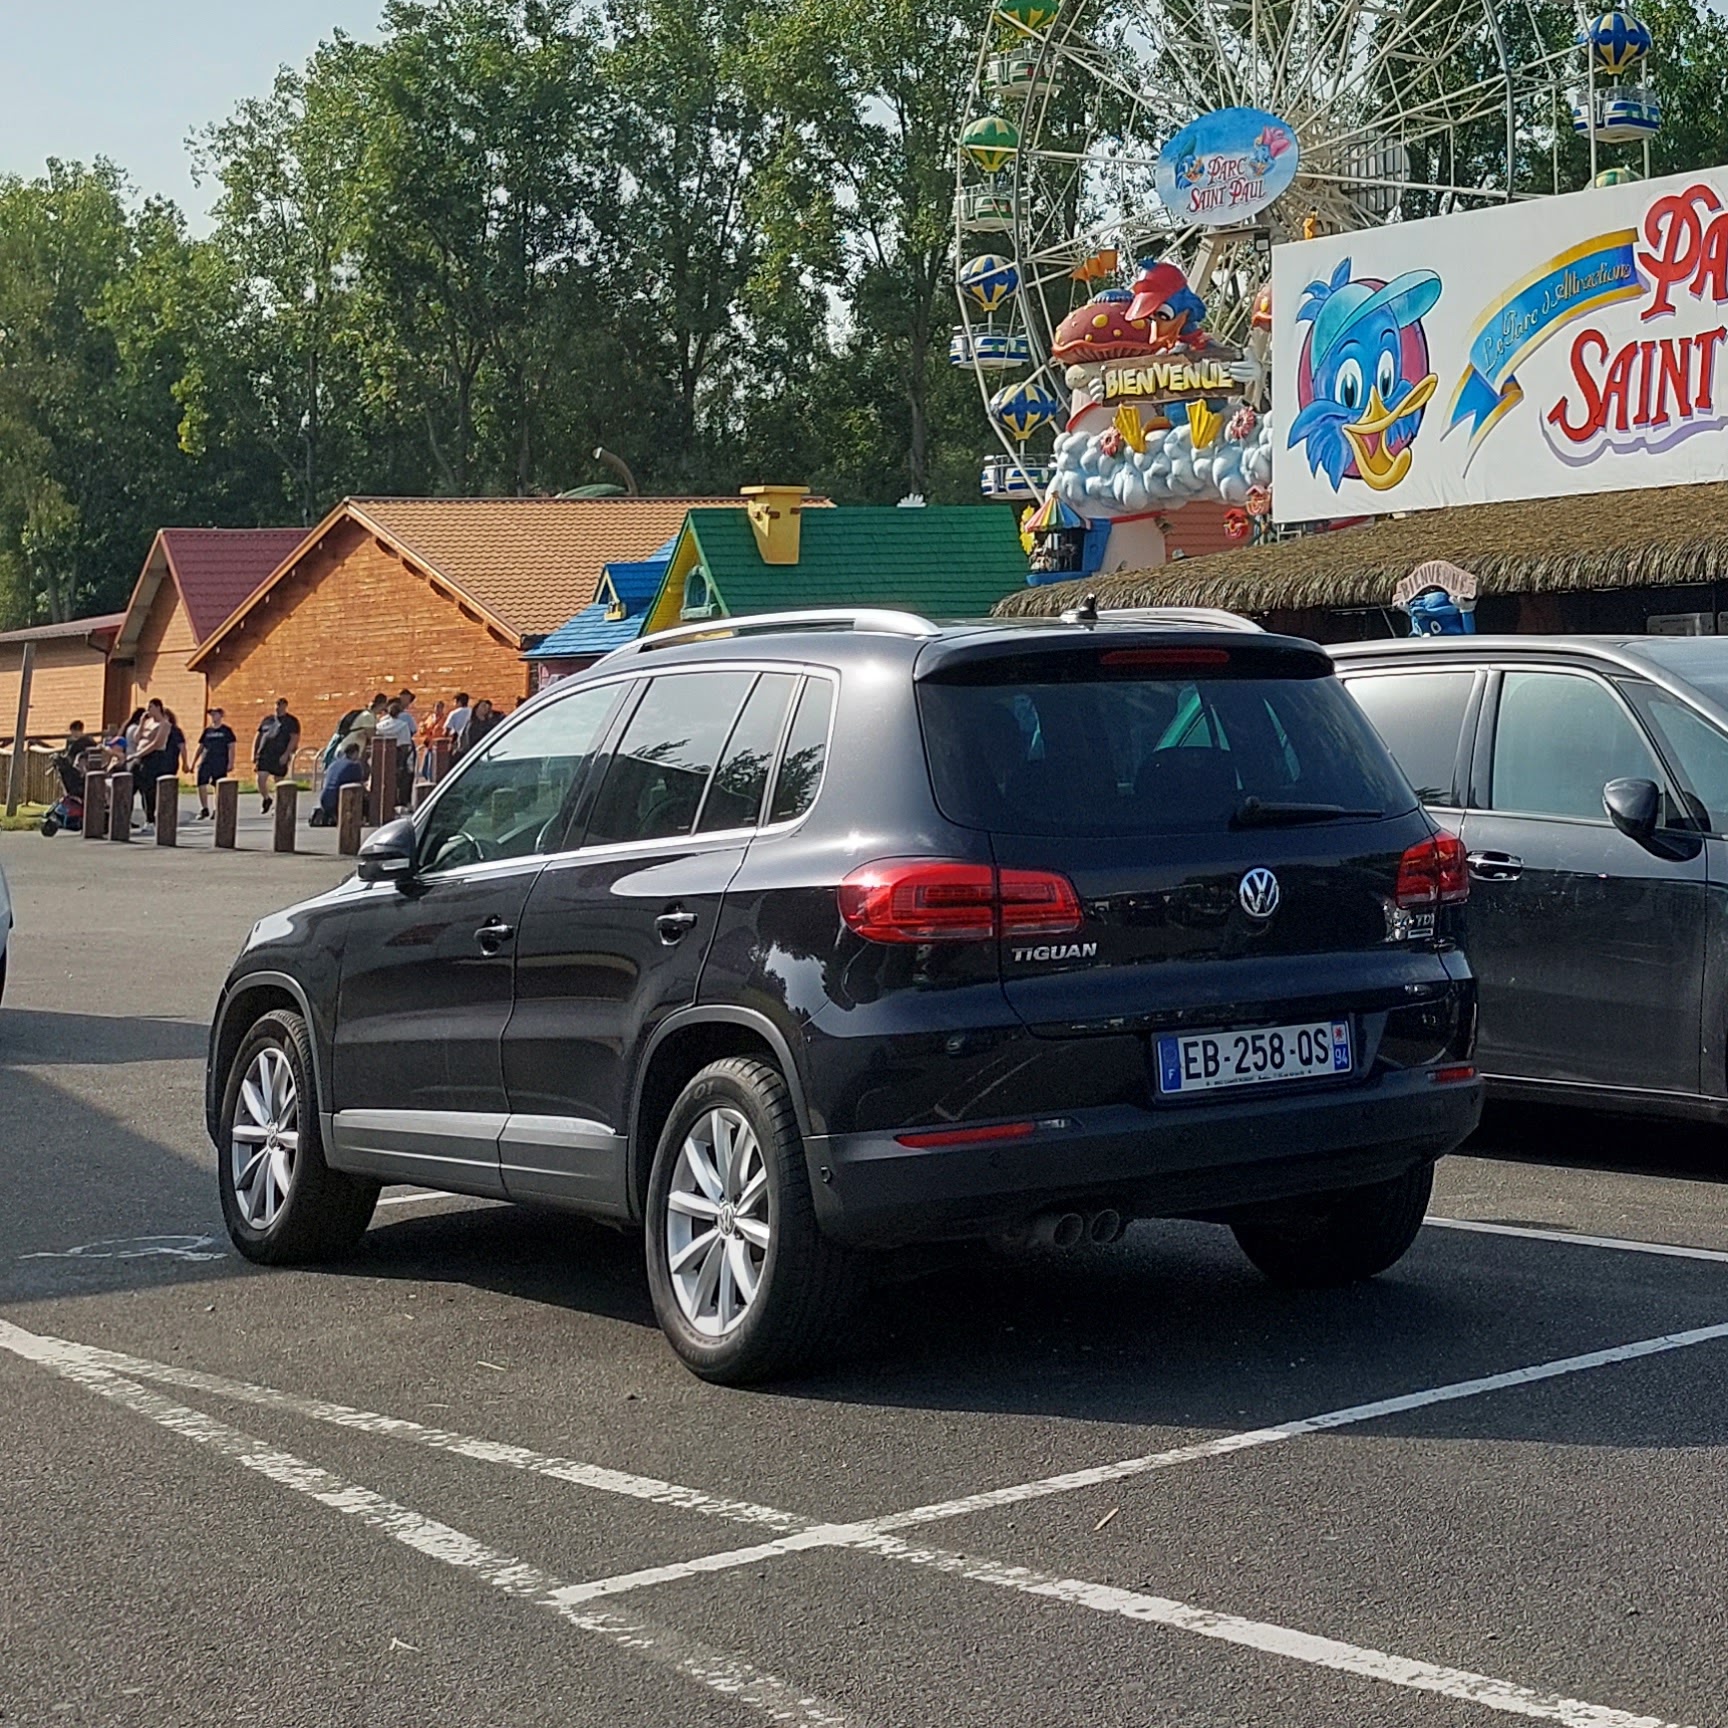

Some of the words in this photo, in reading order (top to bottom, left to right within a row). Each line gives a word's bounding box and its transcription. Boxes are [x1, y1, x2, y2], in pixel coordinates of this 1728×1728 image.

[1207, 155, 1248, 186] PARC
[1186, 186, 1227, 213] SAINT
[1229, 176, 1267, 208] PAUL
[1482, 336, 1505, 377] Le
[1502, 308, 1539, 348] Parc
[1104, 357, 1234, 400] BIENVENUE
[1547, 324, 1728, 443] SAINT
[1011, 942, 1098, 962] TIGUAN
[1182, 1027, 1330, 1081] EB-258-QS
[1334, 1047, 1348, 1064] 94
